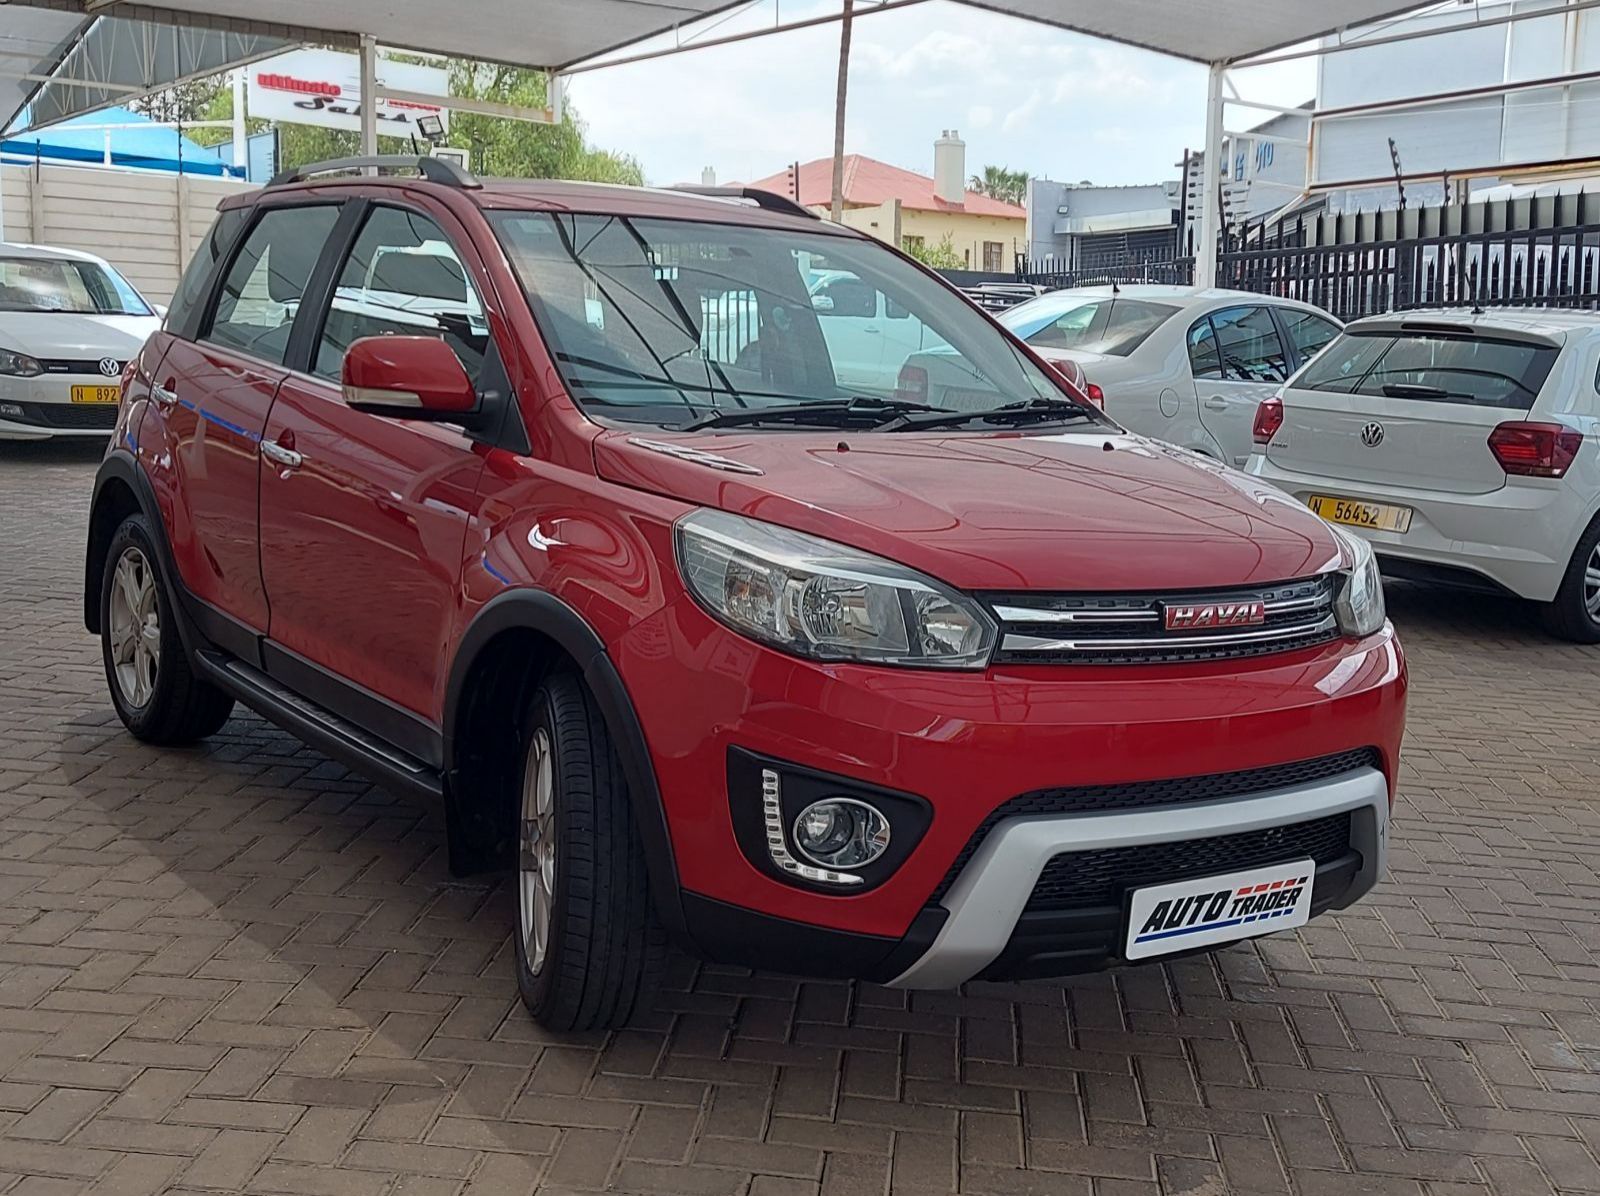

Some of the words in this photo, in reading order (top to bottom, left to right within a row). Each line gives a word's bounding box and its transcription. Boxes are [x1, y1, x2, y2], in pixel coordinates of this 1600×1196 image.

[293, 96, 411, 123] Sals
[76, 387, 84, 401] N
[1312, 498, 1322, 516] N
[1334, 501, 1380, 525] 56452
[1171, 603, 1264, 627] HAVAL
[1139, 889, 1233, 934] AUTO
[1227, 886, 1304, 919] TRADER
